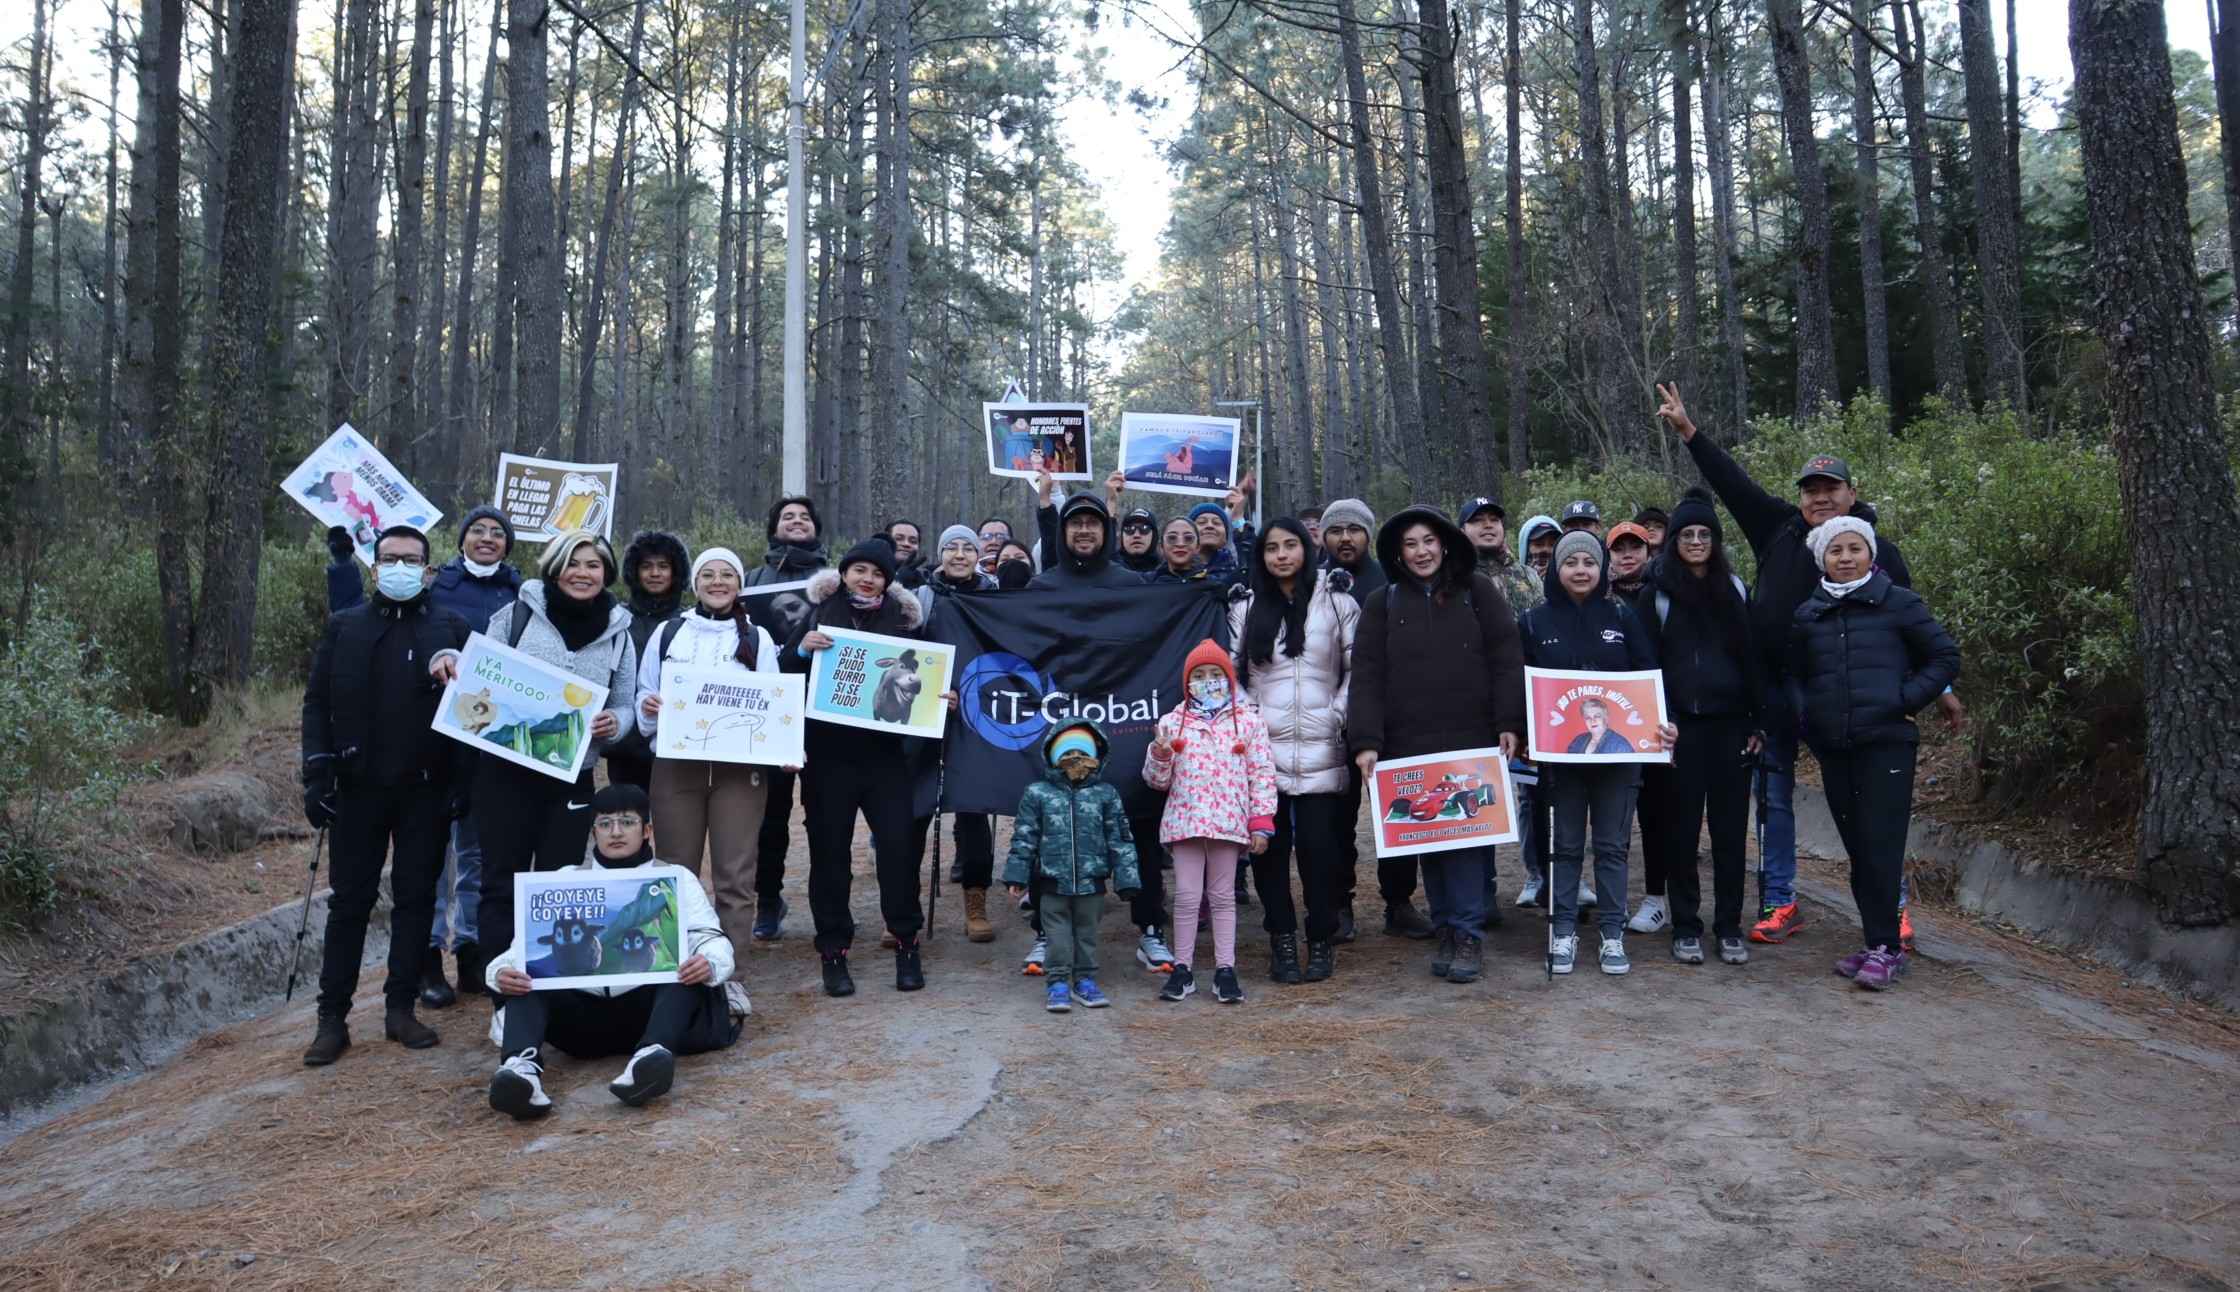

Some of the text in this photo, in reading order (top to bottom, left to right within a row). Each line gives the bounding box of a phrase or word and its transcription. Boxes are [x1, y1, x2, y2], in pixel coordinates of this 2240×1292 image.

[1060, 417, 1083, 425] FUERTES
[1030, 424, 1065, 435] DE ACCIÓN
[354, 466, 398, 509] MENOS DRAMA
[509, 476, 551, 492] EL ÚLTIMO
[507, 488, 551, 504] EN LLEGAR
[507, 501, 547, 516] PAGA LAS
[510, 514, 542, 528] CHELAS
[855, 648, 868, 660] SE
[837, 658, 865, 672] PUDO
[474, 664, 551, 703] MERITOOO!
[832, 668, 866, 684] BURRO
[835, 681, 860, 696] SI SE
[696, 694, 715, 705] HAY
[717, 696, 743, 708] VIENE
[744, 699, 756, 710] TU
[830, 693, 862, 708] PUDO!
[1566, 688, 1578, 701] TE
[1577, 685, 1606, 698] PARES,
[1605, 689, 1635, 711] INÚTIL!
[1393, 770, 1424, 784] TE CREES
[1397, 783, 1423, 796] VELOZ?
[1399, 831, 1429, 841] FRANCESCO
[1430, 829, 1437, 838] ES
[1442, 827, 1460, 837] VECES
[1475, 823, 1492, 833] VELOZ
[531, 888, 605, 908] ¡¡COYEYE
[531, 905, 605, 921] COYEYE!!
